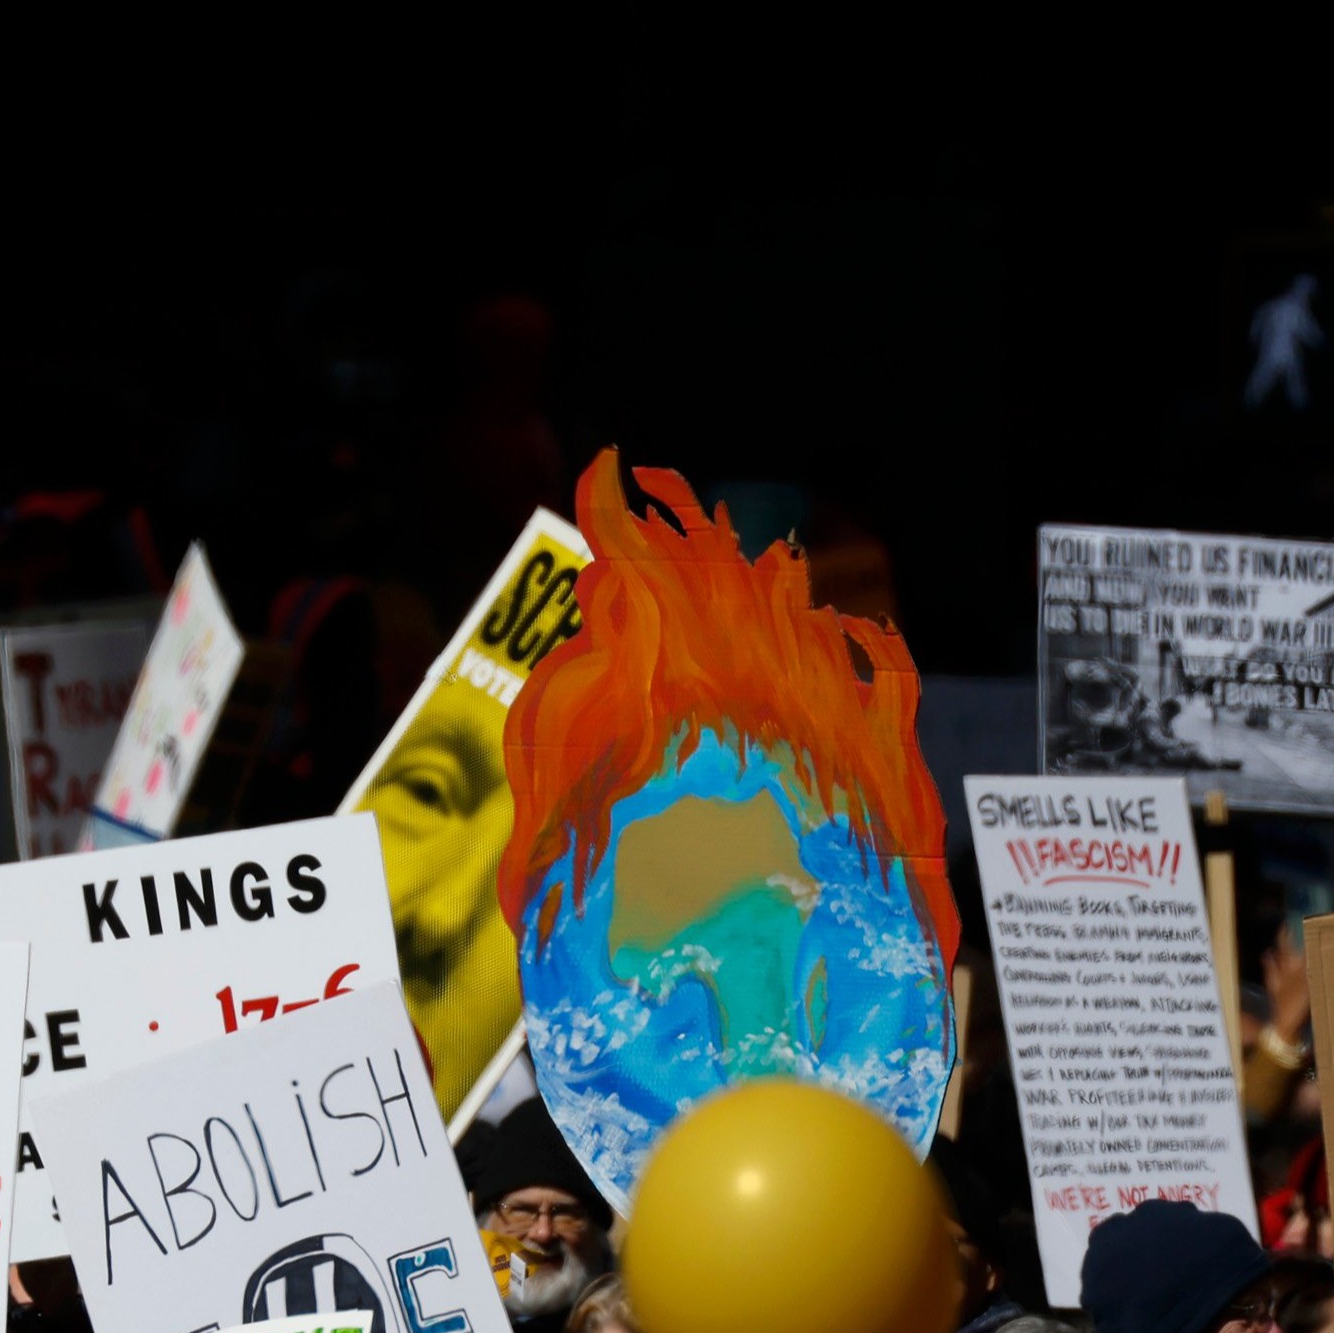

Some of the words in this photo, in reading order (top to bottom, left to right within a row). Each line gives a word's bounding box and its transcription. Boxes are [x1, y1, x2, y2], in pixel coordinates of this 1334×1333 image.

[1045, 534, 1091, 567] YOU
[1102, 536, 1194, 574] RUINED
[1201, 542, 1230, 575] US
[1181, 613, 1255, 643] WORLD
[1259, 619, 1307, 648] WAR
[976, 792, 1082, 833] SMELLS
[1088, 794, 1160, 835] LIKE
[81, 852, 327, 946] KINGS
[1042, 1181, 1112, 1213] WE'RE
[1116, 1183, 1150, 1207] NOT
